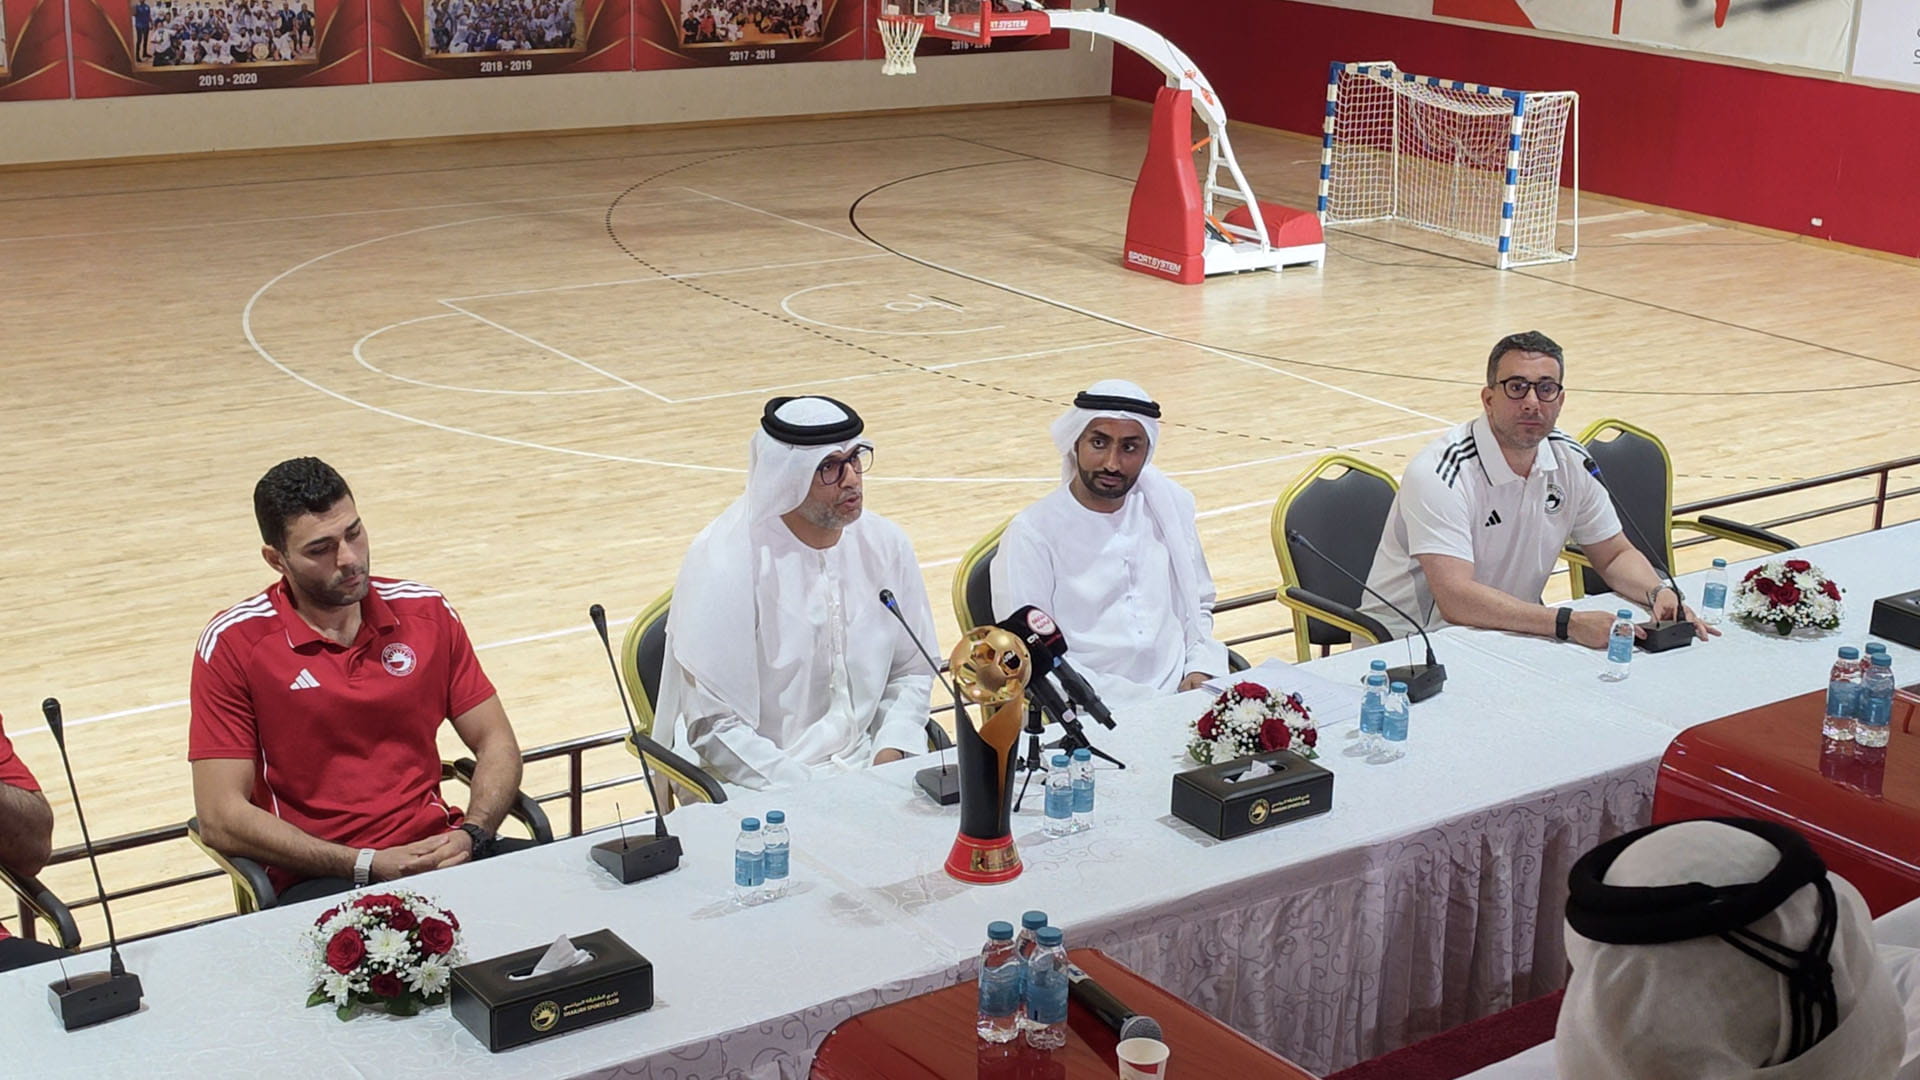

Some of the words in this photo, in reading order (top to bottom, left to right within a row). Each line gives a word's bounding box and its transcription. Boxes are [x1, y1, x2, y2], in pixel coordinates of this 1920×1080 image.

[729, 50, 750, 61] 2017
[756, 49, 776, 60] 2018
[480, 61, 503, 72] 2018
[510, 60, 532, 71] 2019
[199, 74, 225, 87] 2019
[232, 73, 258, 85] 2020
